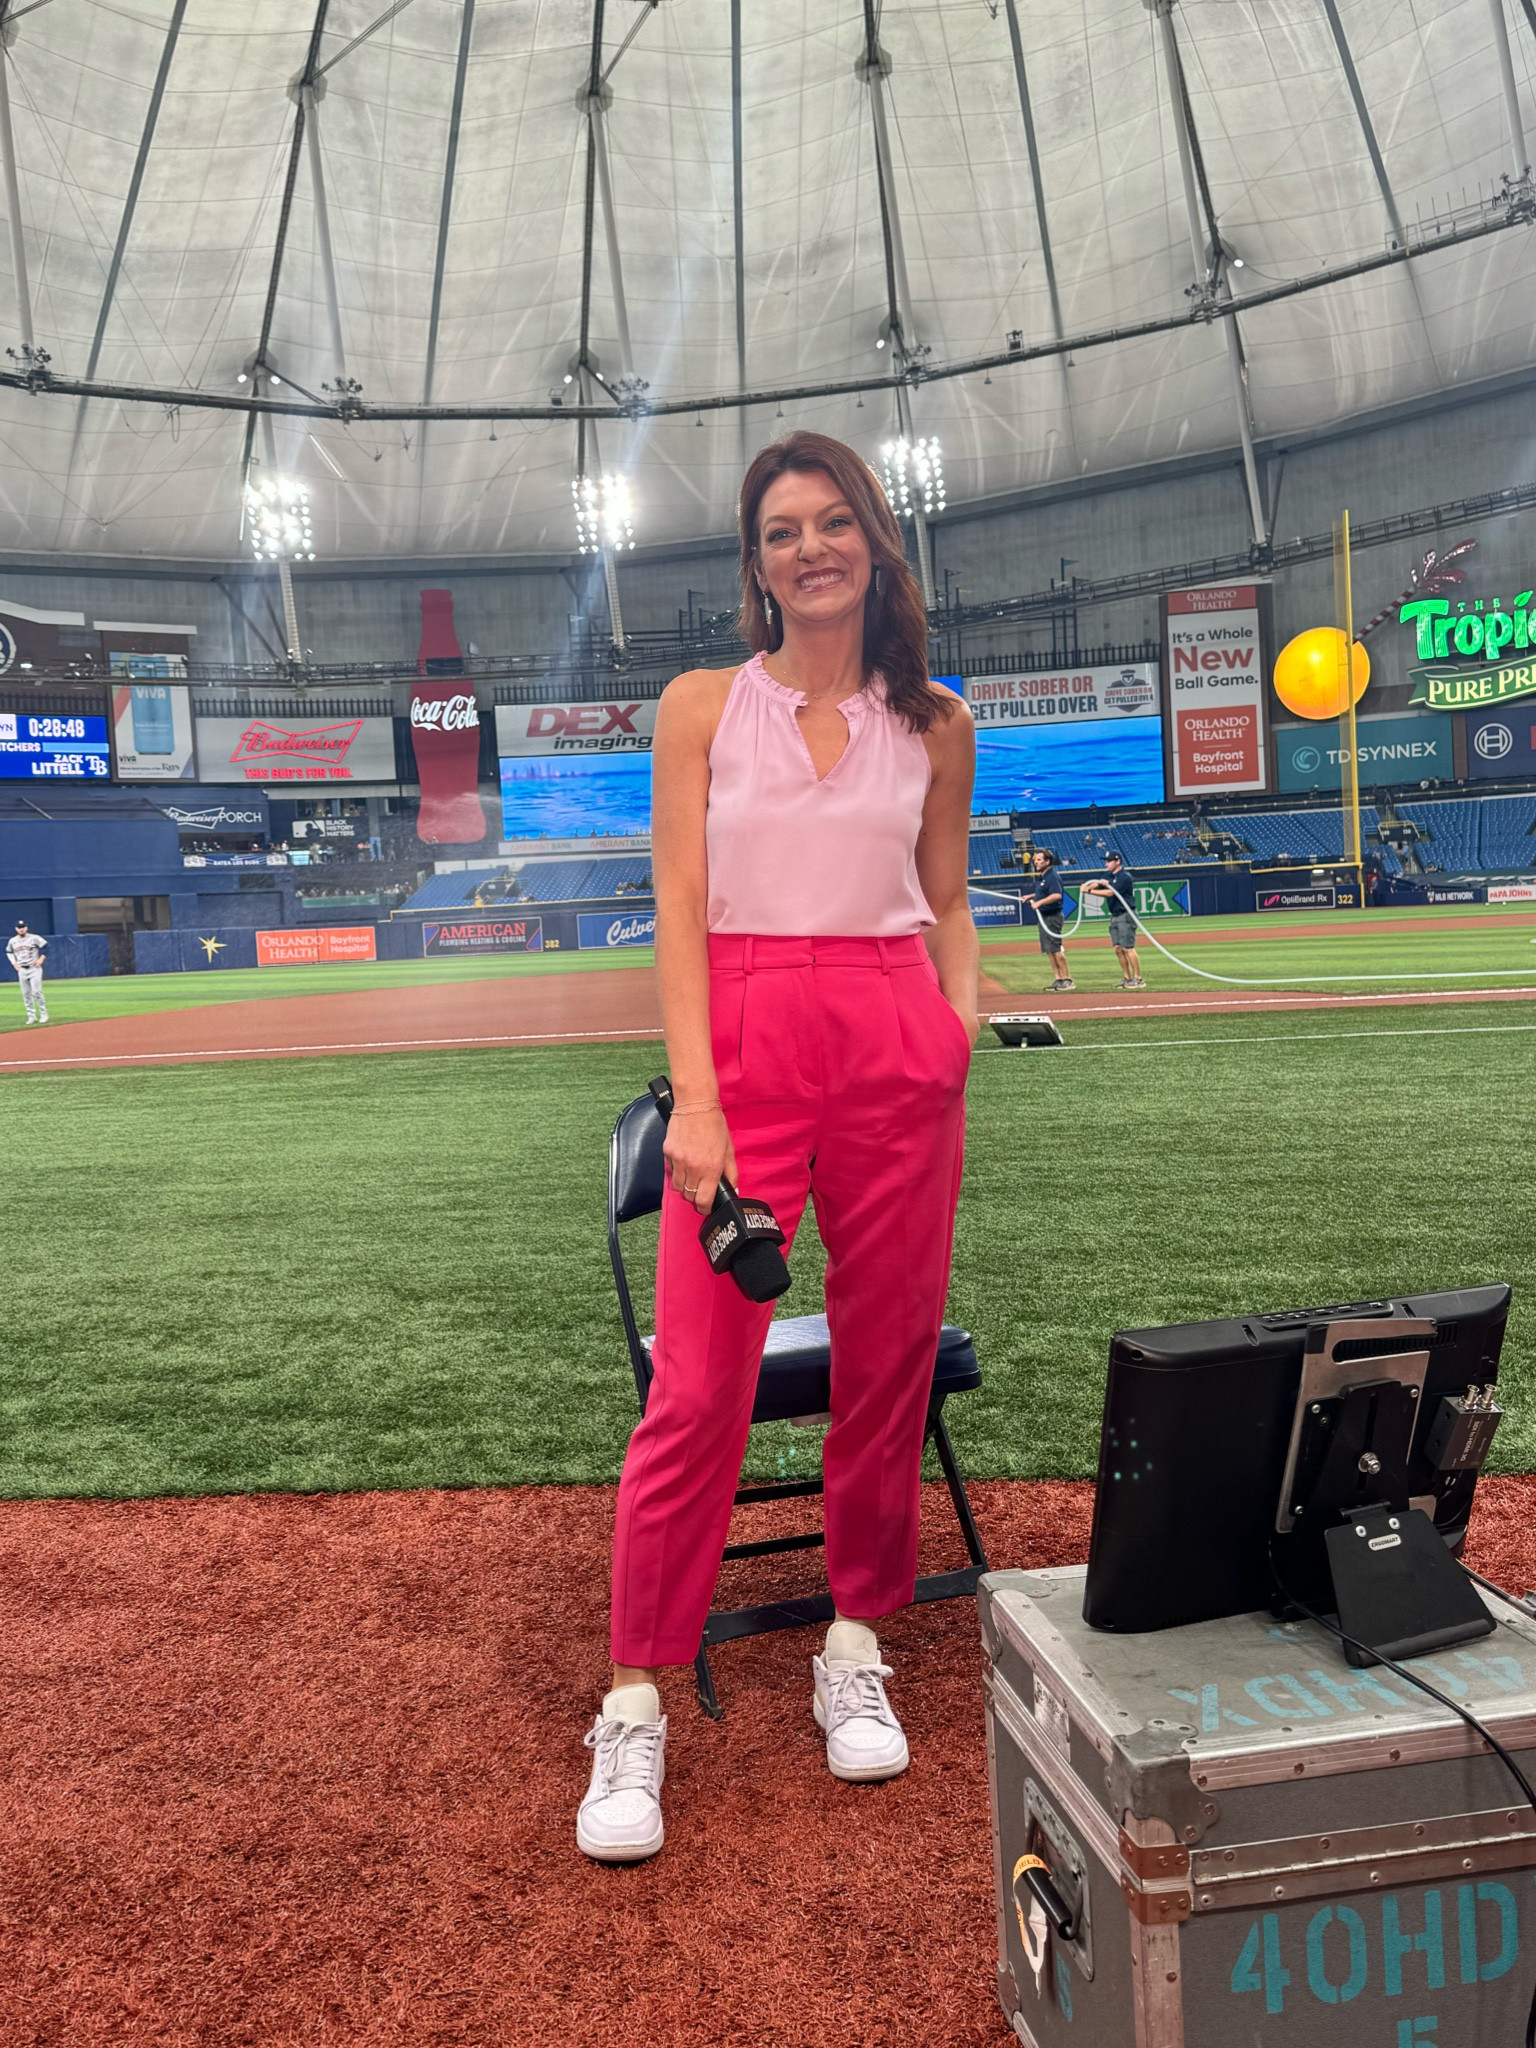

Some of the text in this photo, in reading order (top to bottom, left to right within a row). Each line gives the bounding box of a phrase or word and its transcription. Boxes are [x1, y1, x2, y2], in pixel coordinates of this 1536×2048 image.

[1186, 589, 1237, 602] ORLANDO
[1192, 598, 1233, 611] HEALTH
[1172, 626, 1254, 644] It's a Whole
[1173, 646, 1254, 673] New
[971, 675, 1094, 701] DRIVE SOBER OR
[1175, 673, 1259, 690] Ball Game.
[135, 687, 167, 700] VIVA
[1428, 676, 1493, 704] PURE
[411, 695, 480, 731] Coca-Cola
[1000, 698, 1056, 719] PULLED
[1058, 695, 1098, 715] OVER
[28, 718, 85, 737] 0:28:48
[526, 703, 644, 738] DEX
[1184, 715, 1251, 732] ORLANDO
[241, 731, 351, 752] Budweiser
[553, 734, 653, 751] imaging
[1192, 728, 1244, 742] HEALTH
[53, 754, 84, 764] ZACK
[1192, 748, 1245, 766] Bayfront
[1326, 741, 1437, 765] TD SYNNEX
[31, 762, 85, 775] LITTELL
[244, 767, 269, 779] THIS
[271, 767, 303, 779] BUD'S
[305, 767, 326, 779] FOR
[1194, 761, 1244, 776] Hospital
[219, 811, 262, 824] PORCH
[978, 818, 1001, 828] BANK
[1281, 893, 1328, 905] OptiBrand Rx
[1337, 894, 1354, 905] 322
[1435, 891, 1474, 901] MLB NETWORK
[1489, 889, 1508, 899] PAPA
[439, 922, 527, 941] AMERICAN
[606, 919, 656, 946] Culve
[261, 934, 371, 949] ORLANDO Bayfront
[544, 939, 560, 948] 382
[270, 942, 370, 959] HEALTH Hospital
[1371, 1535, 1399, 1549] ERGOMART
